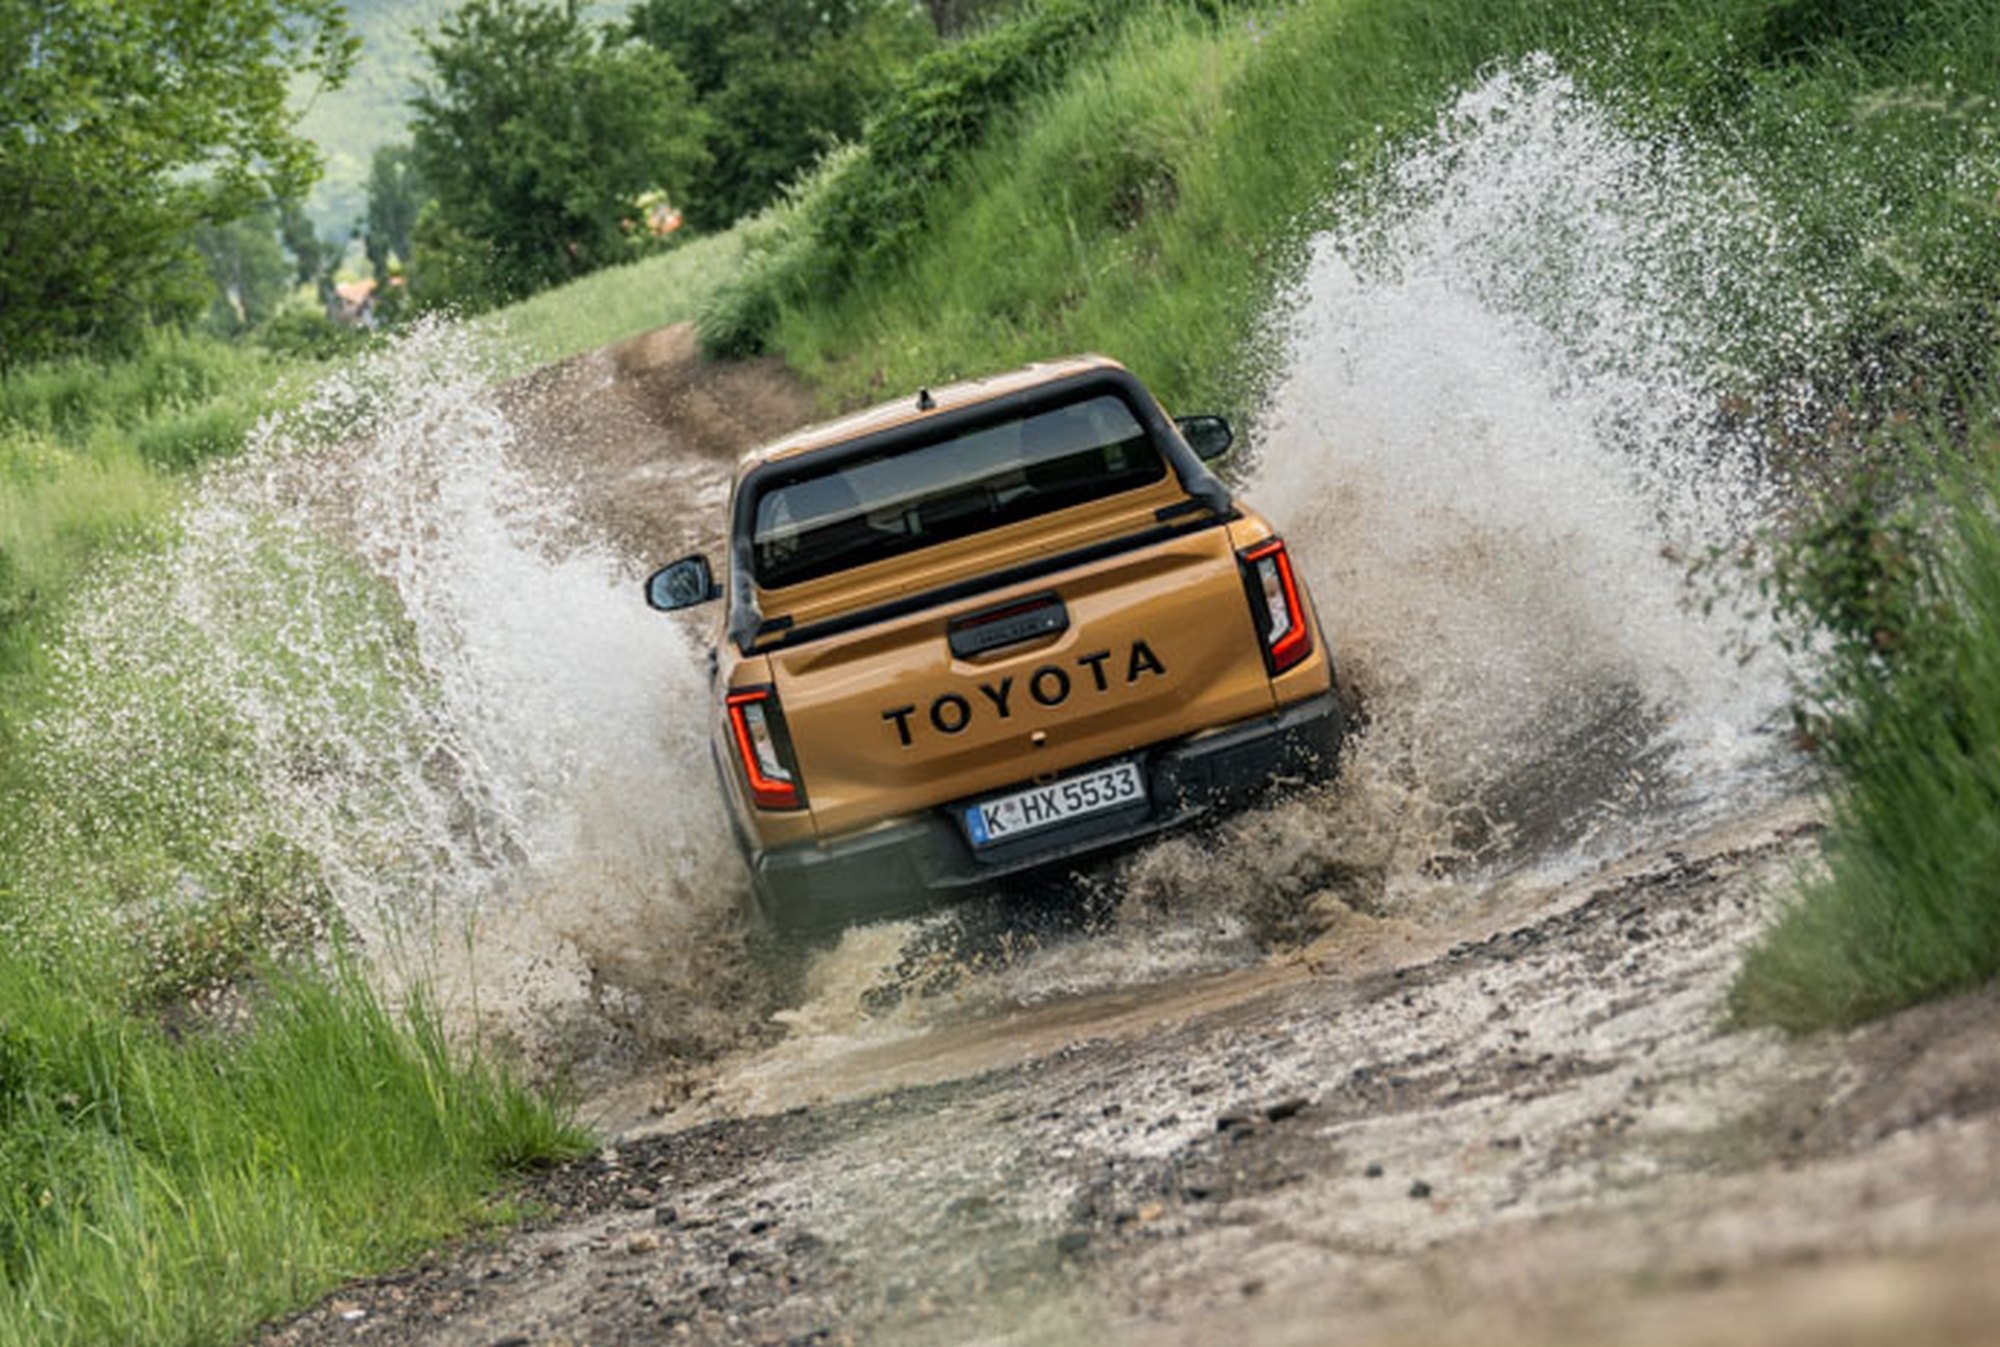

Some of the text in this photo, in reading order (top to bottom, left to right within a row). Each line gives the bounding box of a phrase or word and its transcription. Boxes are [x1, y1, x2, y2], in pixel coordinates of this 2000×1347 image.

[882, 639, 1166, 746] TOYOTA
[984, 769, 1136, 835] K HX 5533
